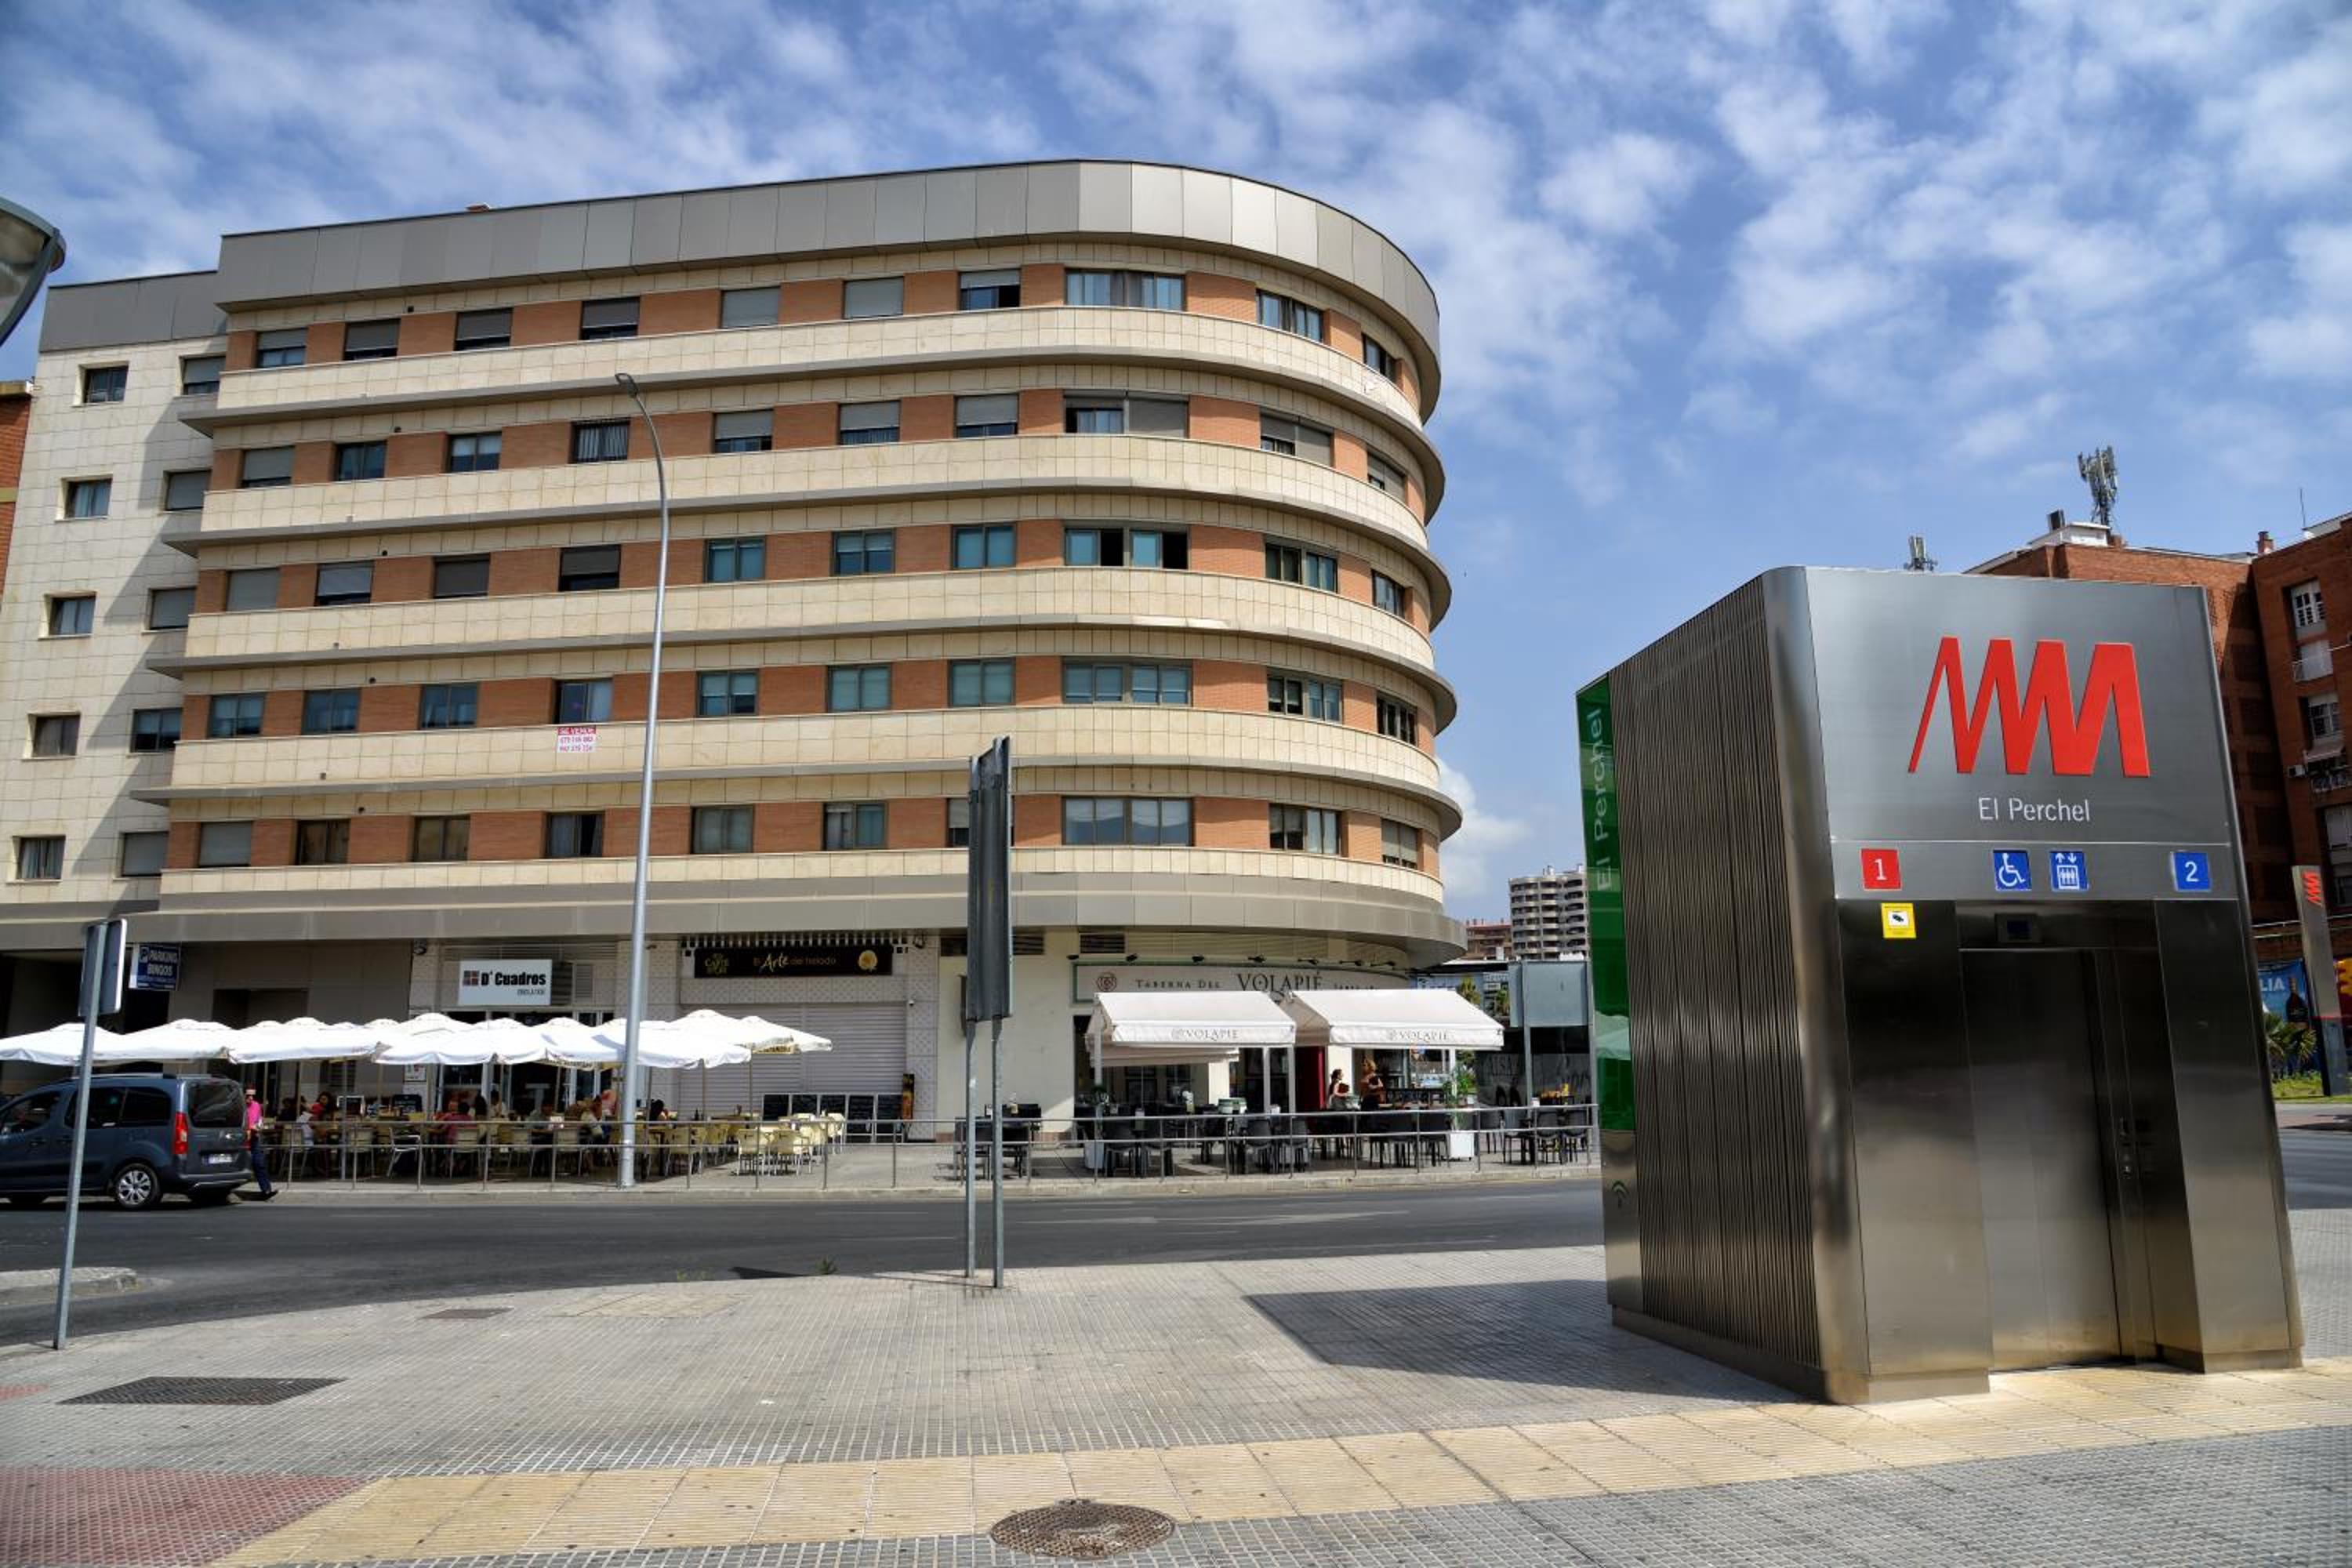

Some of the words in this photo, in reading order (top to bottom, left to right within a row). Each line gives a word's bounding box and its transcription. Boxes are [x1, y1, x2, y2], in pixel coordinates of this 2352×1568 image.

[1586, 708, 1610, 842] Perchel
[1978, 797, 1999, 820] El
[2008, 797, 2091, 822] Perchel
[1596, 856, 1613, 891] El
[1875, 858, 1887, 880] 1
[2185, 861, 2199, 882] 2
